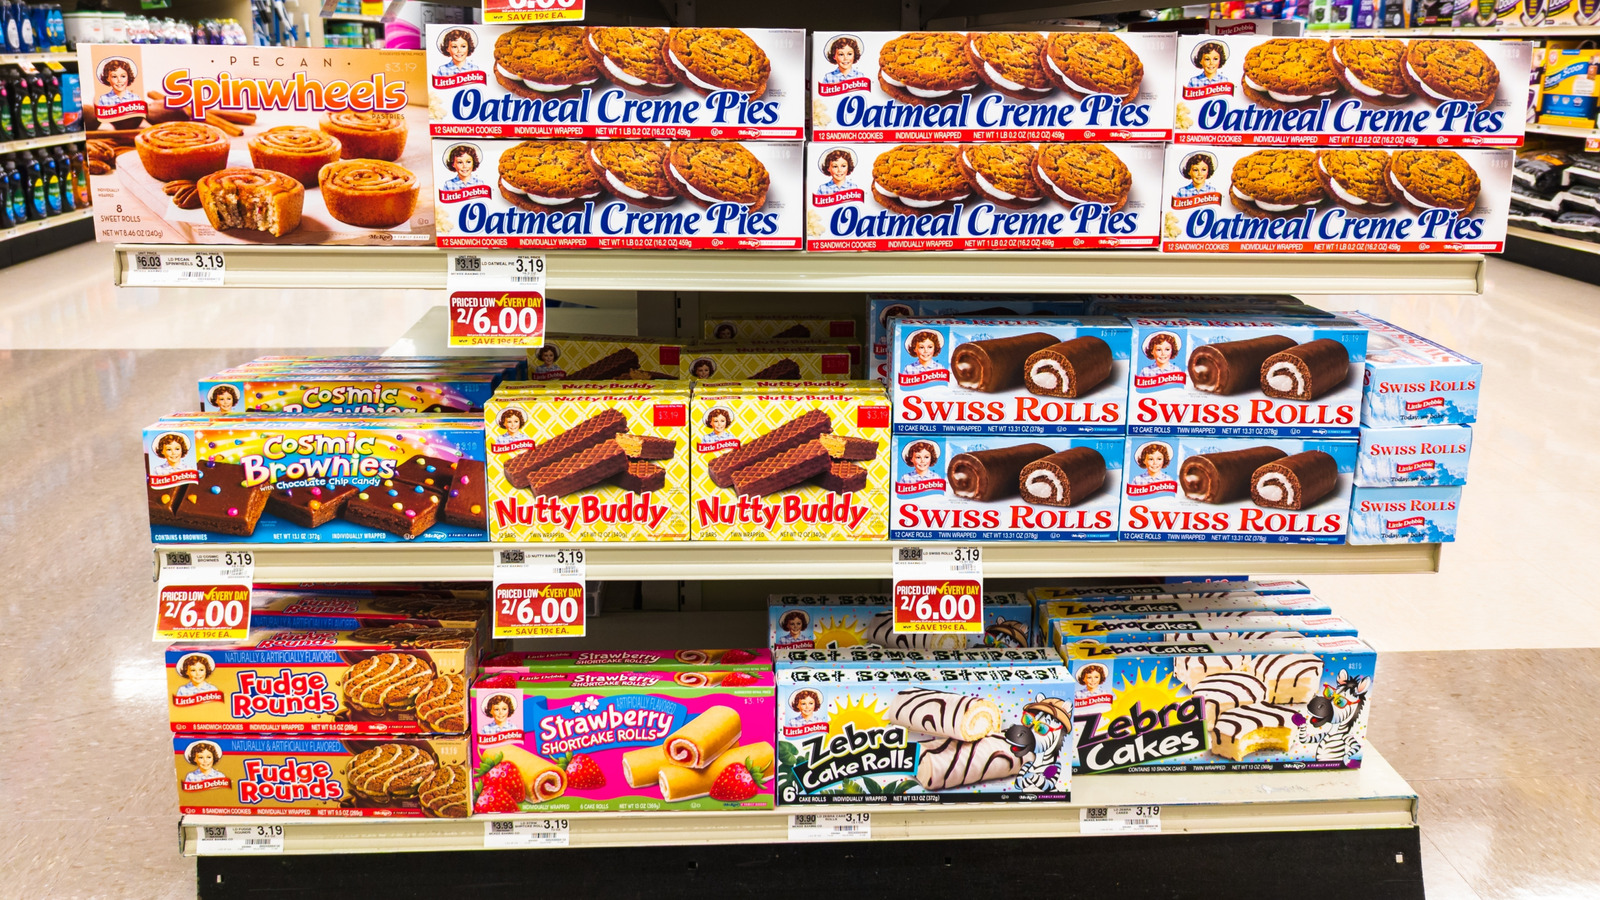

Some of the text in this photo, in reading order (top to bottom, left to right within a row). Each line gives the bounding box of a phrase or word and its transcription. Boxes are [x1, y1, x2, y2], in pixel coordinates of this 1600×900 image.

[230, 56, 332, 67] PECAN
[385, 63, 417, 72] $3.19
[435, 73, 483, 86] Little Debbie
[164, 69, 408, 120] Spinwheels
[97, 104, 145, 116] Little Debbie
[451, 88, 779, 124] Oatmeal Creme Pies
[836, 94, 1149, 128] Oatmeal Creme Pies
[1198, 99, 1504, 133] Oatmeal Creme Pies
[458, 202, 777, 235] Oatmeal Creme Pies
[830, 203, 1137, 238] Oatmeal Creme Pies
[1186, 207, 1484, 240] Oatmeal Creme Pies
[146, 230, 163, 238] (240g)
[138, 256, 161, 268] $6.03
[196, 256, 223, 268] 3.19
[457, 259, 480, 268] $3.15
[516, 259, 543, 272] 3.19
[452, 298, 541, 307] PRICED LOW EVERY DAY
[901, 372, 947, 384] Little Debbie
[1136, 374, 1183, 386] Little Debbie
[302, 384, 399, 408] Cosmic
[262, 432, 376, 460] Cosmic
[492, 441, 534, 454] Little Debbie
[241, 455, 397, 487] Brownies
[151, 472, 197, 484] Little Debbie
[260, 476, 381, 492] with Chocolate Chip Candy
[495, 492, 670, 530] Nutty Buddy
[699, 492, 870, 530] Nutty Buddy
[169, 554, 190, 562] $3.90
[225, 554, 251, 565] 3.19
[502, 553, 523, 561] $4.25
[558, 552, 583, 563] 3.19
[955, 550, 979, 561] 3.19
[224, 652, 336, 662] NATURALLY & ARTIFICIALLY FLAVORED
[237, 670, 327, 695] Fudge
[176, 693, 221, 705] Little Debbie
[231, 692, 338, 717] Rounds
[617, 697, 676, 714] ARTIFICIALLY FLAVORED
[1075, 695, 1110, 706] ittle Debbie
[539, 706, 674, 740] Strawberry
[1075, 697, 1205, 746] Zebra
[785, 725, 827, 736] Little Debbie
[479, 732, 522, 744] Little Debbie
[542, 728, 657, 754] SHORTCAKE ROLLS
[802, 723, 908, 770] Zebra
[1086, 730, 1199, 769] Cakes
[245, 758, 332, 782] Fudge
[802, 750, 913, 790] Cake Rolls
[239, 781, 343, 804] Rounds
[783, 788, 795, 801] 6
[845, 813, 870, 822] 3.19
[1136, 807, 1160, 815] 3.19
[257, 826, 282, 835] 3.19
[544, 820, 568, 829] 3.19
[205, 828, 225, 836] $5.37
